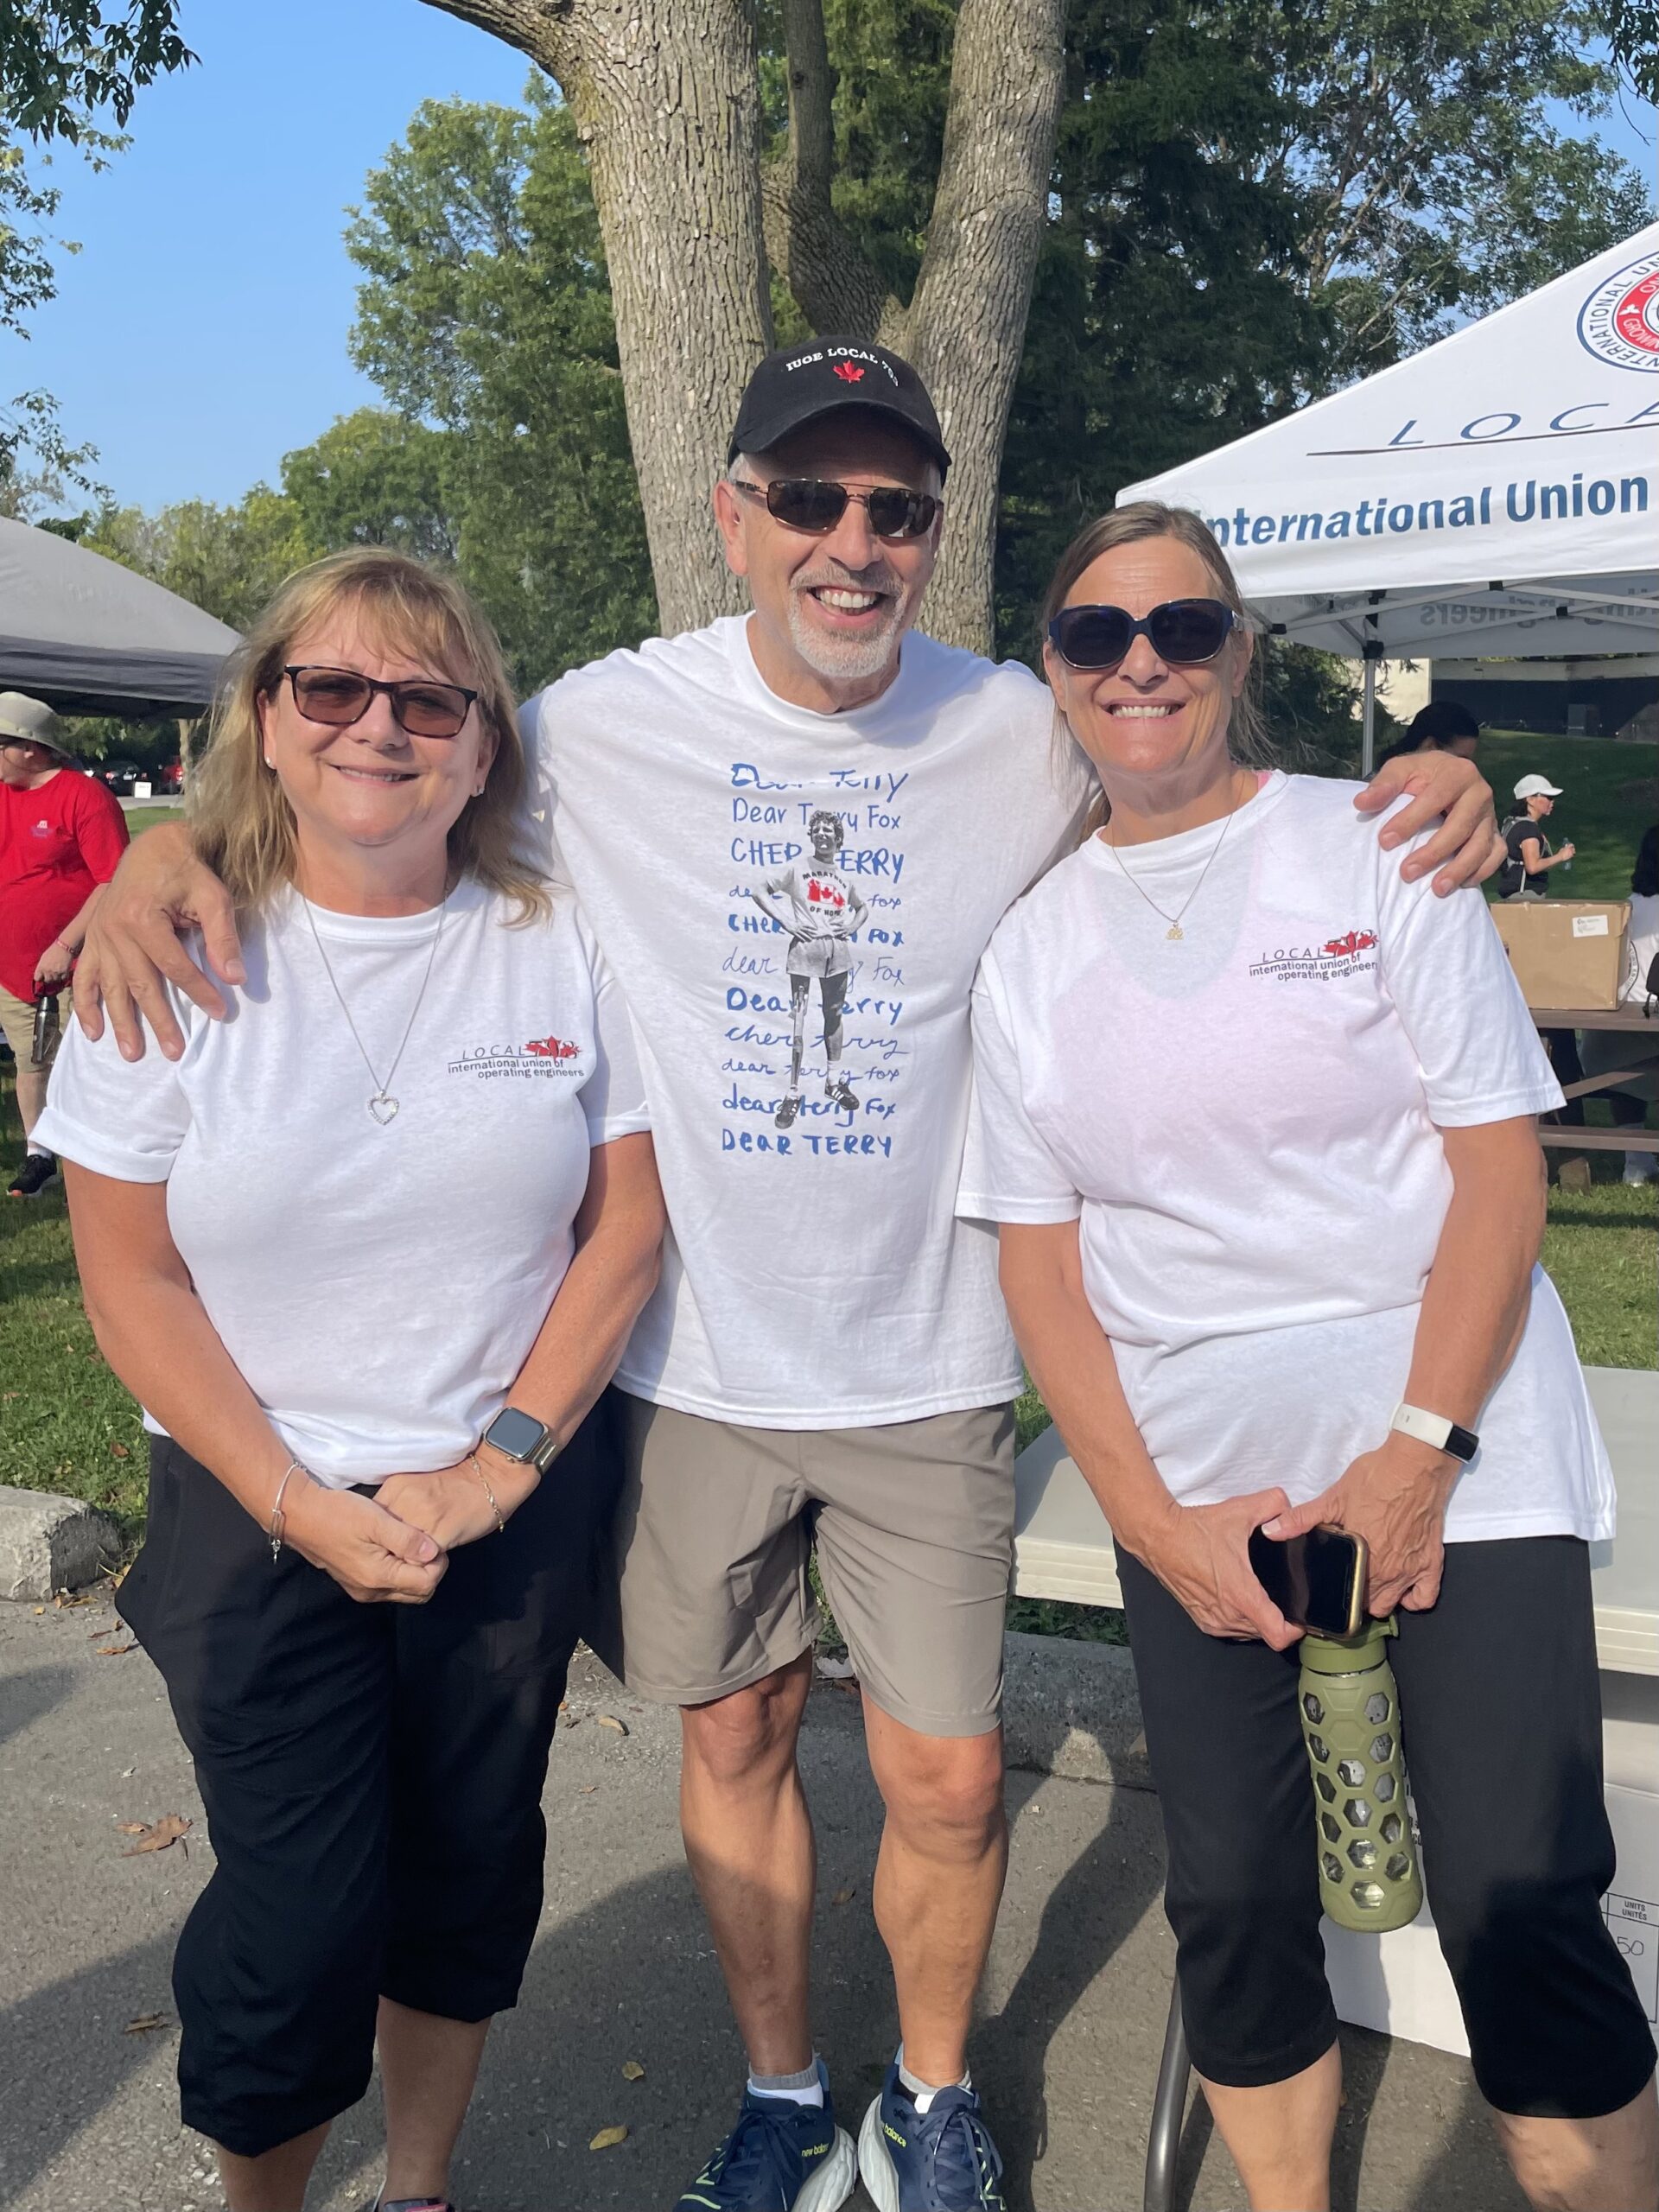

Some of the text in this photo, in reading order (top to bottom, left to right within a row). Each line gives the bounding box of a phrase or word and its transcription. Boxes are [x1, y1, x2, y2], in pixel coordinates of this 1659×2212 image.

[1590, 281, 1659, 367] NTERNATIONAL
[785, 352, 823, 372] IUOE
[827, 347, 878, 364] LOCAL
[1194, 473, 1649, 548] nternational Union
[733, 797, 787, 823] Dear
[867, 804, 901, 830] Fox
[835, 848, 905, 884] ERRY
[722, 946, 778, 975] dear
[1249, 951, 1360, 977] international union of
[1262, 947, 1324, 963] LOCAL
[1278, 969, 1330, 982] operating
[462, 1044, 525, 1060] LOCAL
[448, 1058, 563, 1074] international union of
[478, 1067, 585, 1079] operating engineers
[722, 1058, 777, 1075] dear
[866, 1097, 896, 1121] Fox
[801, 1134, 892, 1159] TERRY
[1624, 1900, 1645, 1912] UNITS
